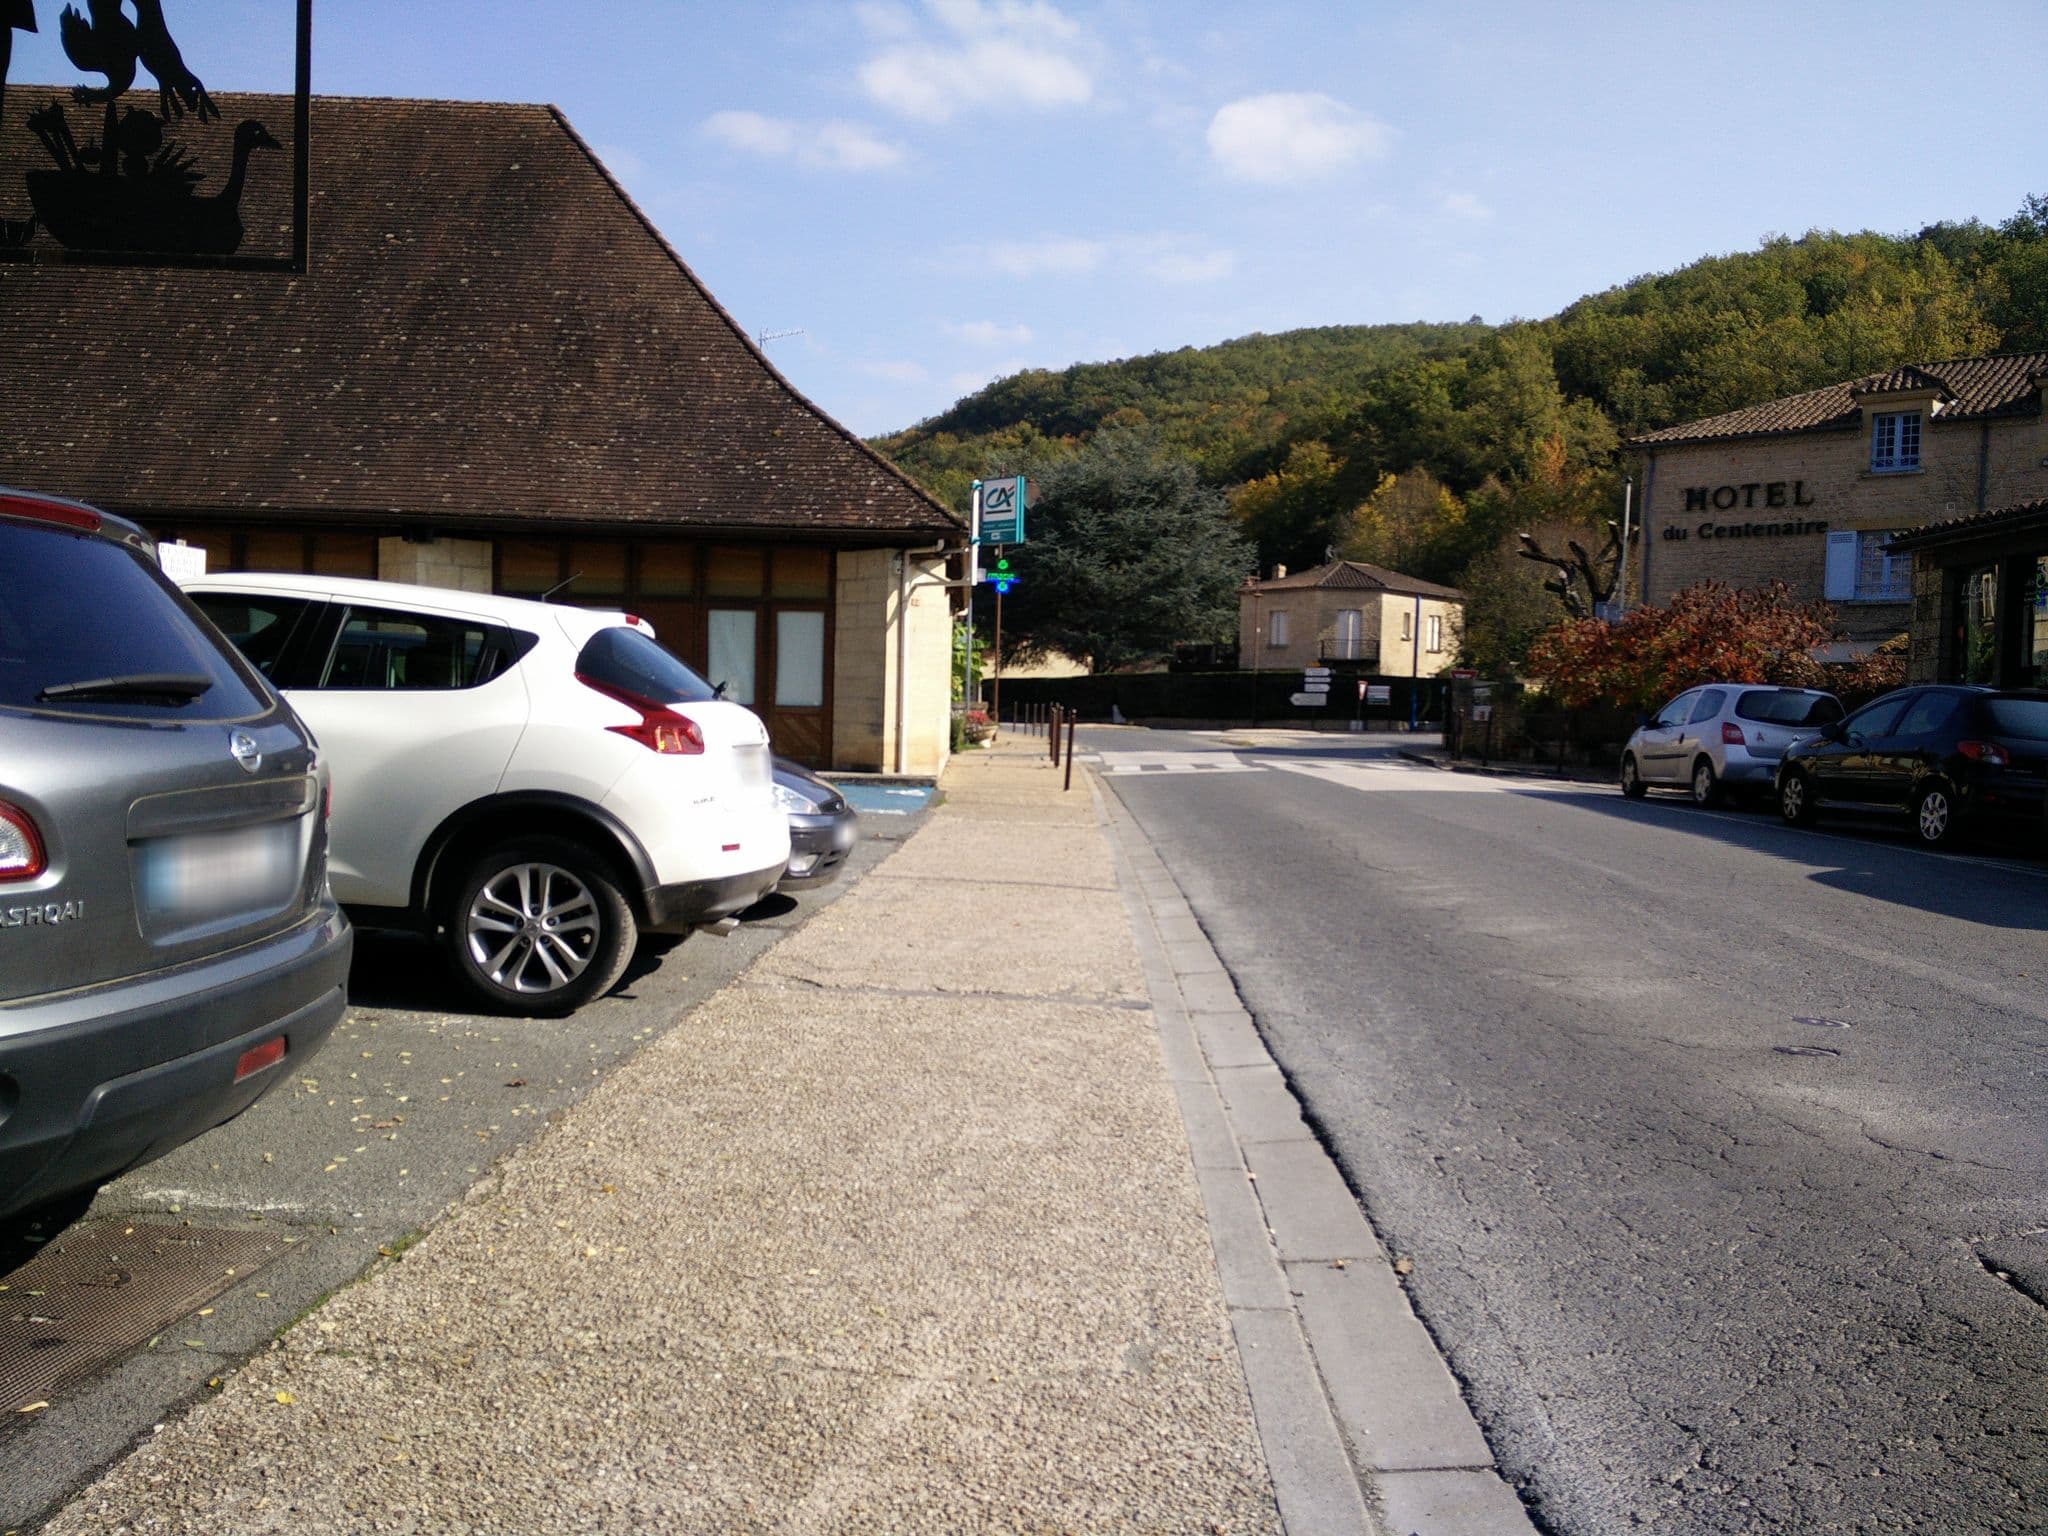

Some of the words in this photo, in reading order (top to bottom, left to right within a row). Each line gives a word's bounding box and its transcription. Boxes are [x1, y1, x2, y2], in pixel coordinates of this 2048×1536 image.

[1684, 480, 1815, 512] HOTEL
[1663, 525, 1687, 540] du
[1698, 519, 1829, 539] Centenaire
[0, 901, 84, 927] SHQAI
